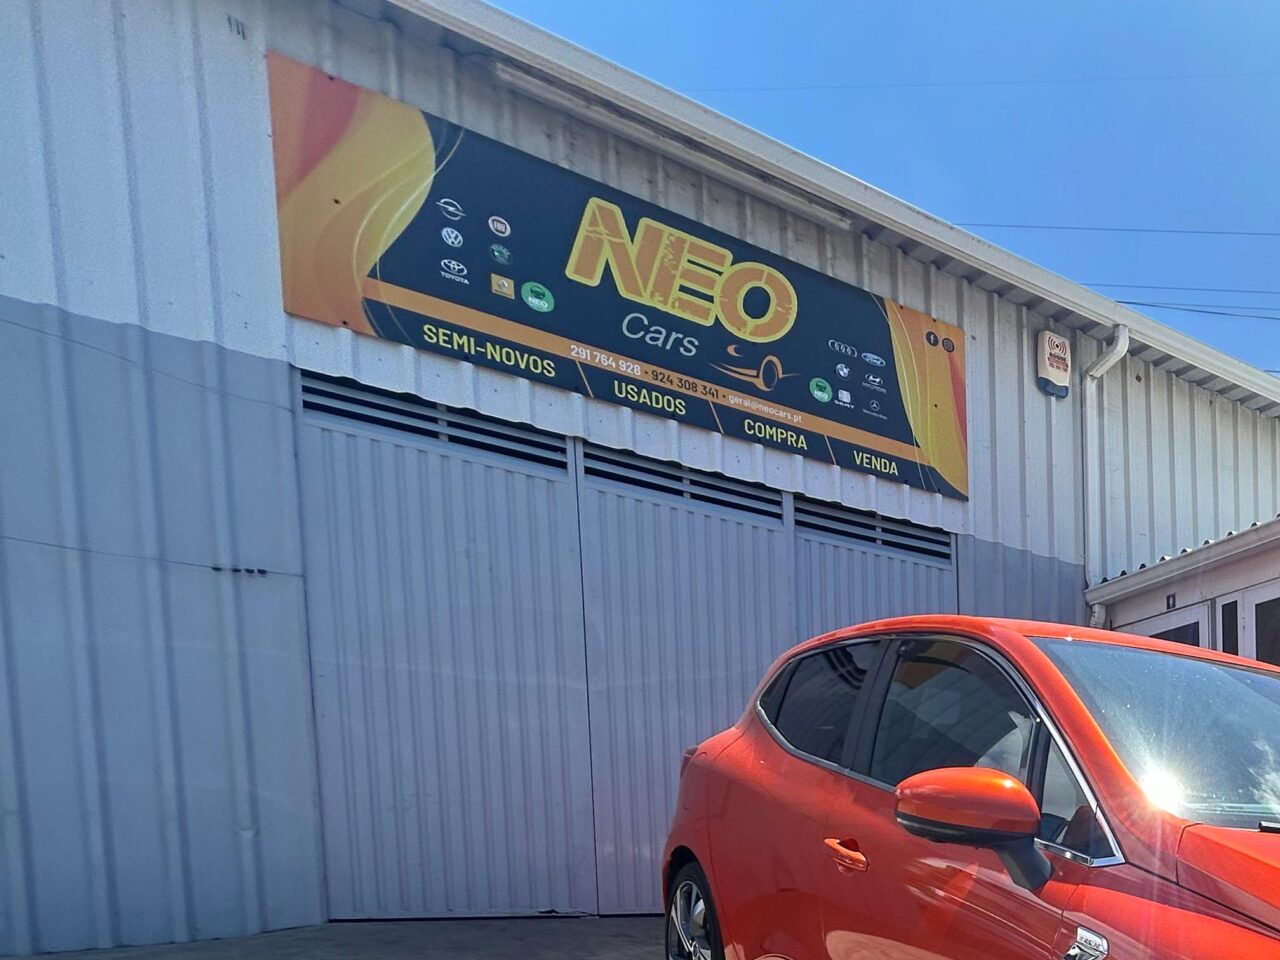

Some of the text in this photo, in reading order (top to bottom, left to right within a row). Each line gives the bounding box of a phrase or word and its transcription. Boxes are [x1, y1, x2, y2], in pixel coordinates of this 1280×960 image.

[440, 271, 470, 285] TOYOTA
[565, 196, 798, 344] NEO
[422, 323, 557, 378] SEMI-NOVOS
[621, 312, 700, 357] Cars
[570, 344, 803, 424] 291 764 928 924 308 341 geral@neocars.pt
[613, 379, 687, 416] USADOS
[743, 418, 808, 451] COMPRA
[853, 449, 900, 477] VENDA
